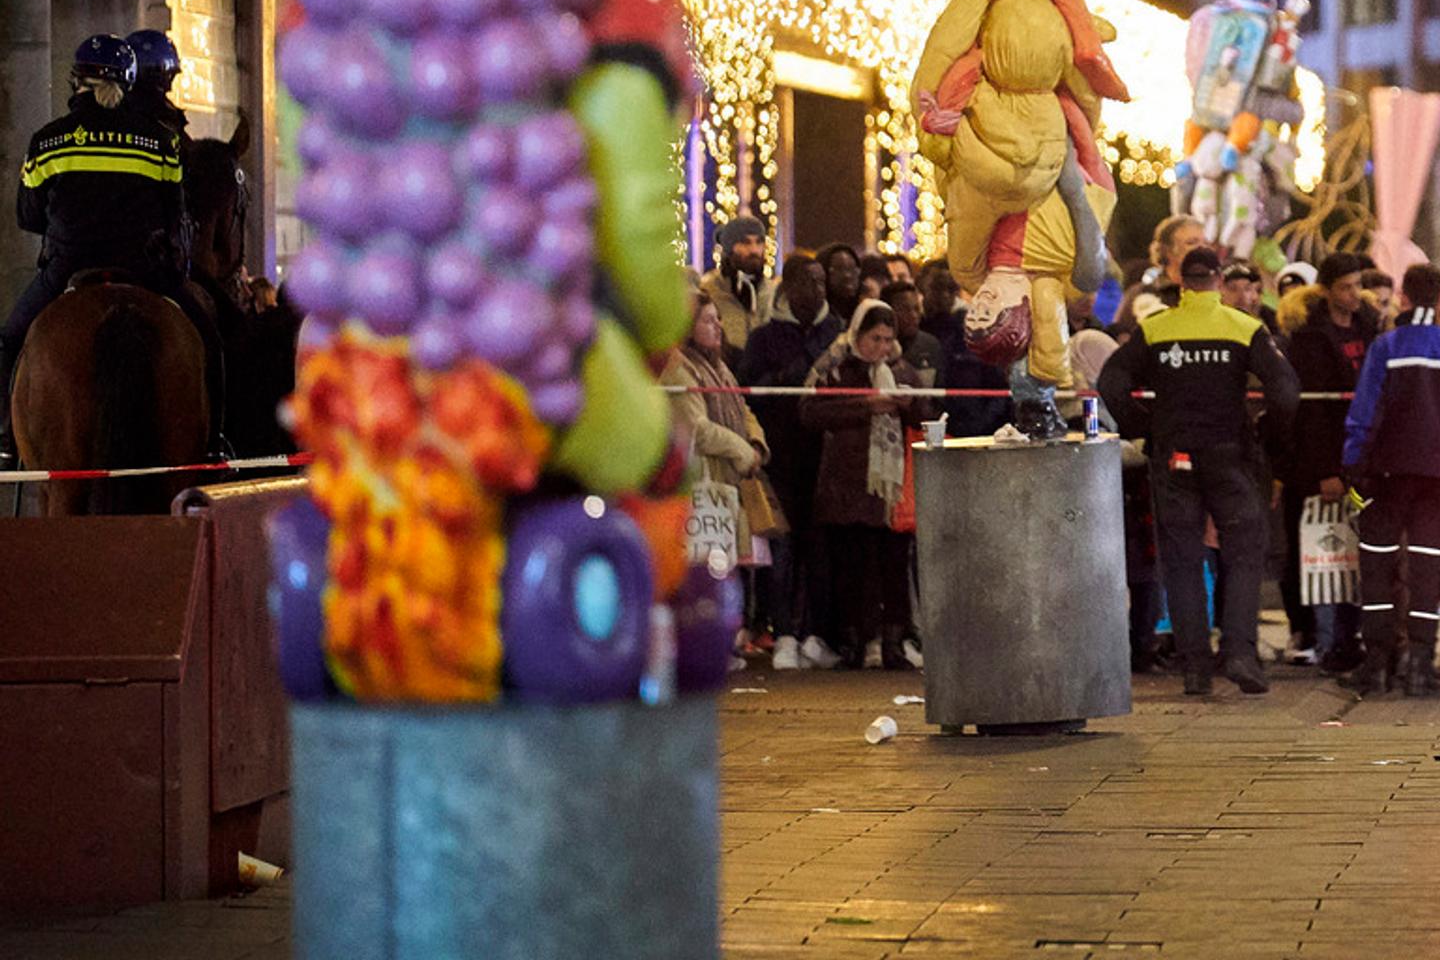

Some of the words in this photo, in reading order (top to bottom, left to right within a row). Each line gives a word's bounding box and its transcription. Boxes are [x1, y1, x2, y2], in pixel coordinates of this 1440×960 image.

[64, 124, 133, 146] POLITIE
[1160, 343, 1231, 368] POLITIE
[691, 488, 732, 509] EW
[684, 515, 733, 536] ORK
[694, 541, 733, 561] ITY
